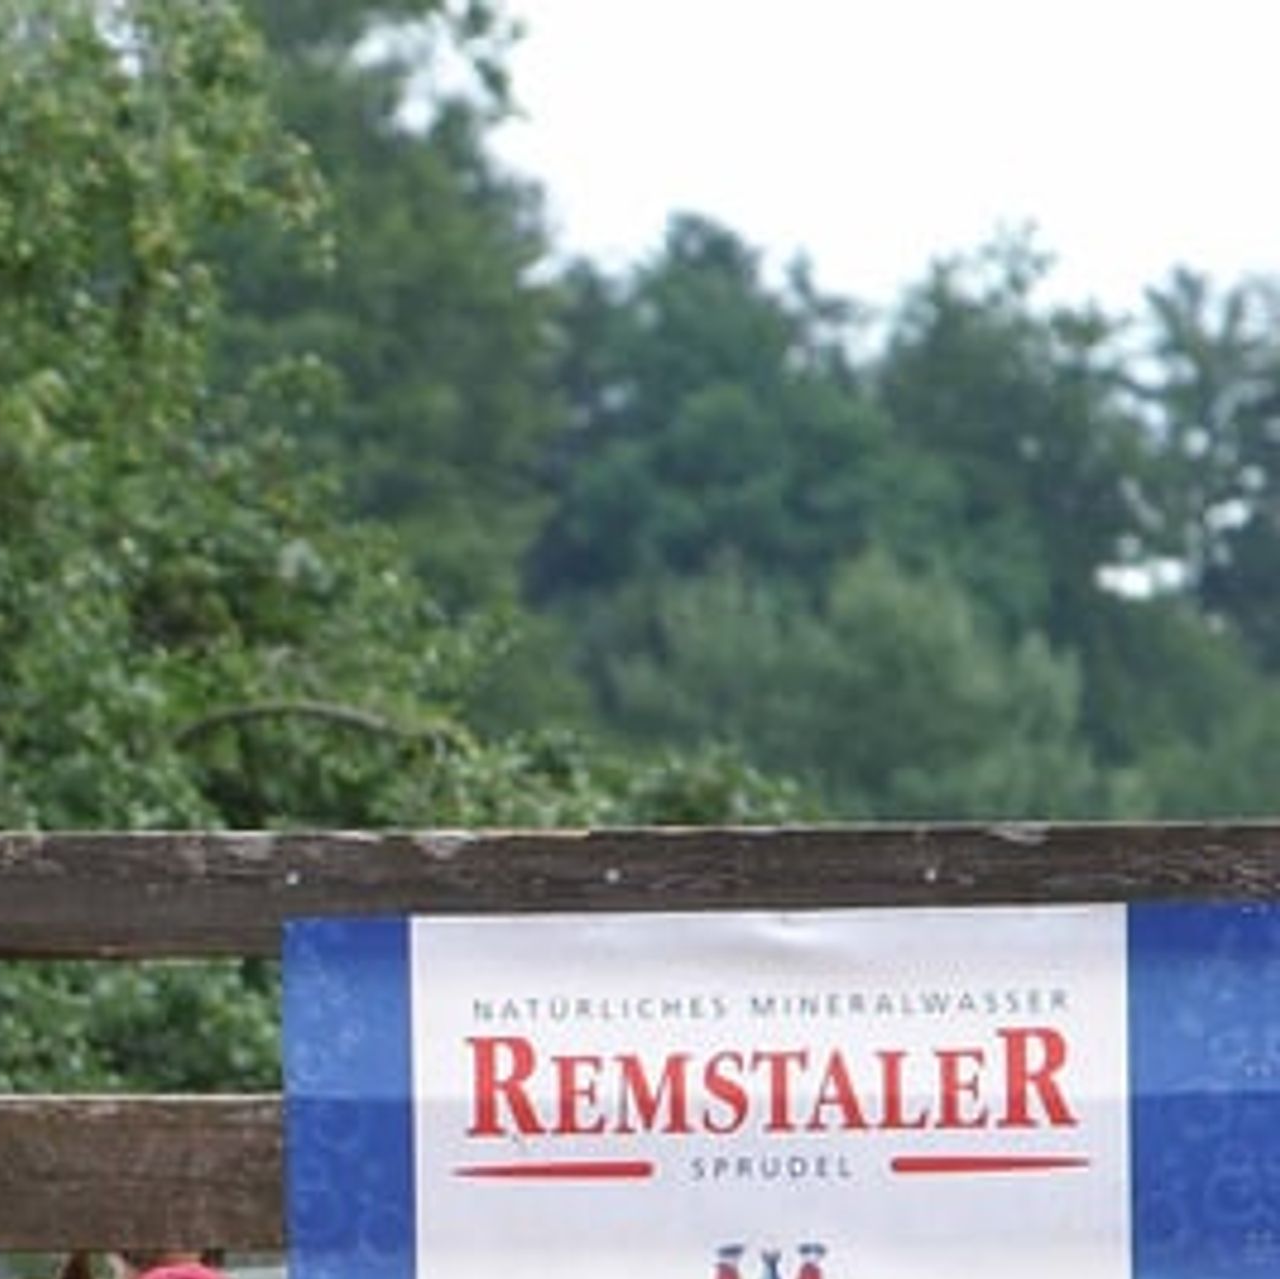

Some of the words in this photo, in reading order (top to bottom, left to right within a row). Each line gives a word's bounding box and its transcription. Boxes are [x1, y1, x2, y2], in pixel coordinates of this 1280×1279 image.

[473, 994, 727, 1021] NATÜRLICHES
[751, 989, 1068, 1016] MINERALWASSER
[464, 1027, 1078, 1137] REMSTALER
[689, 1155, 853, 1181] SPRUDEL
